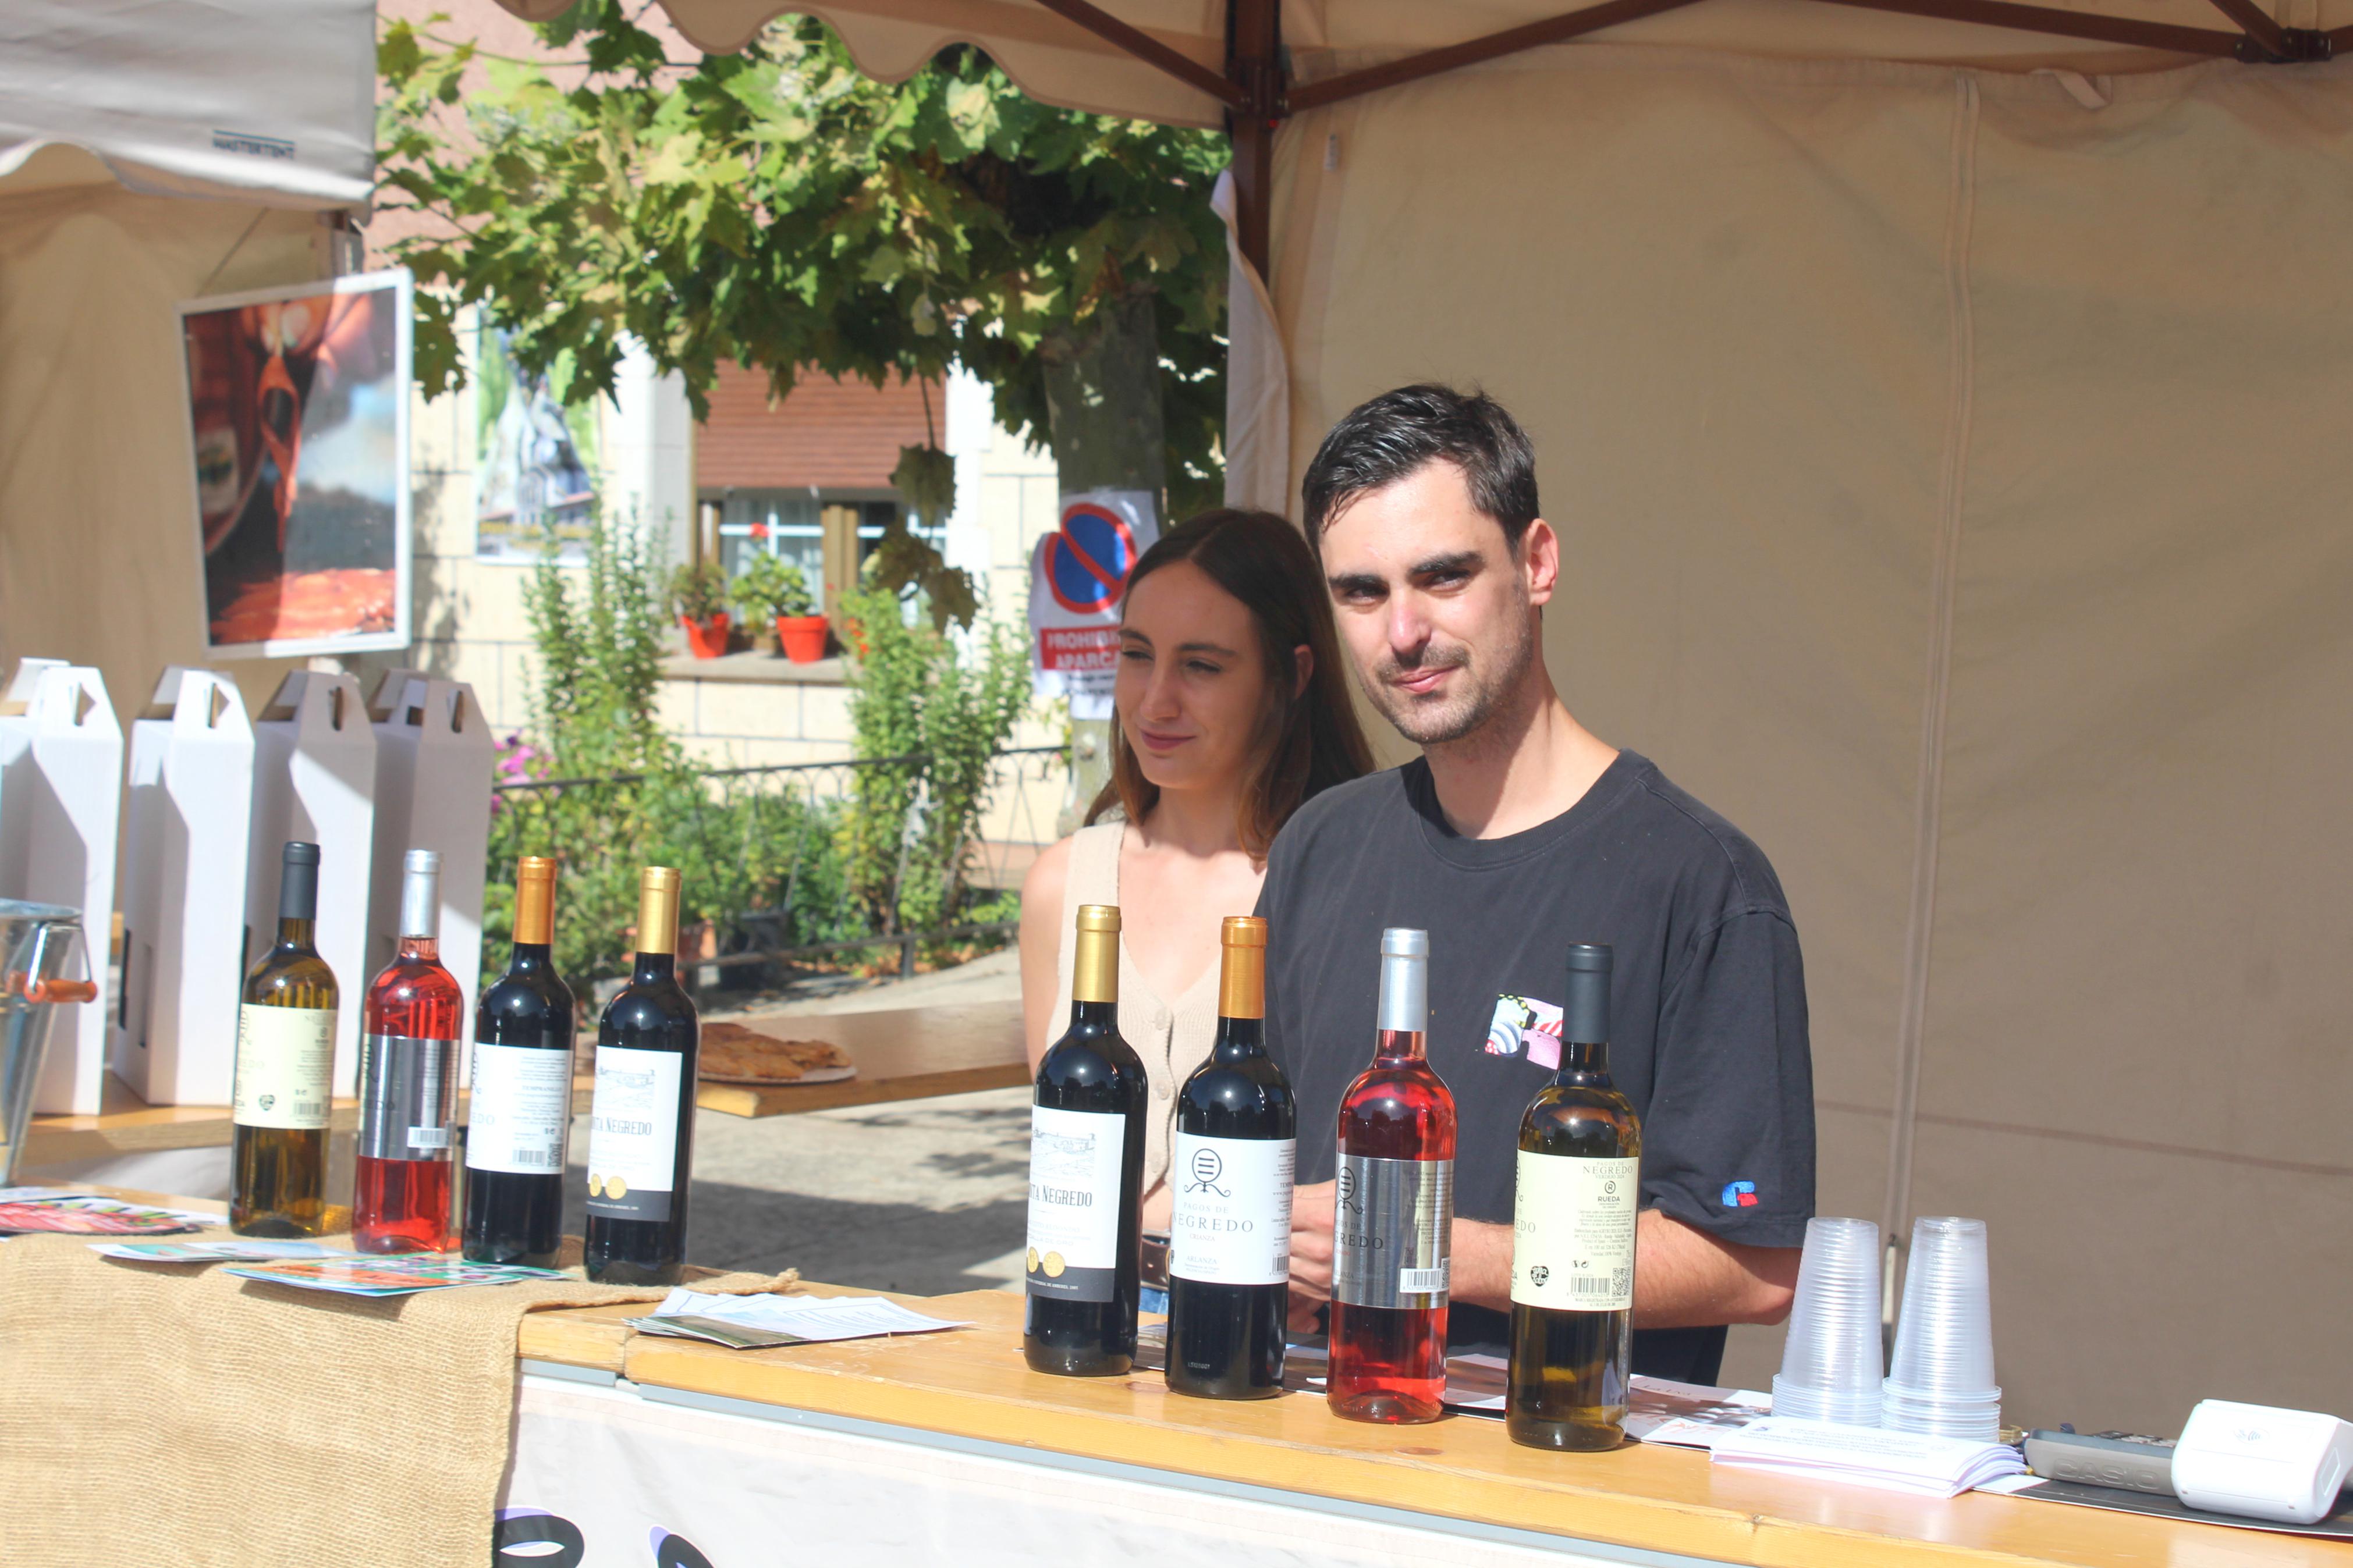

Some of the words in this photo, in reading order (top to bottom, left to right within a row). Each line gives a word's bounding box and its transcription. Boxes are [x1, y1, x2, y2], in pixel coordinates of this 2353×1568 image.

[214, 138, 294, 159] MASTERTENT
[606, 1117, 652, 1136] NEGREDO
[1583, 1165, 1632, 1174] NEGREDO
[1042, 1185, 1092, 1207] NEGREDO
[1184, 1201, 1211, 1212] PAGOS
[1173, 1211, 1254, 1232] NEGREDO
[1190, 1233, 1215, 1242] CRIANZA
[1186, 1255, 1217, 1264] ARLANZA
[2054, 1458, 2159, 1489] CASIO
